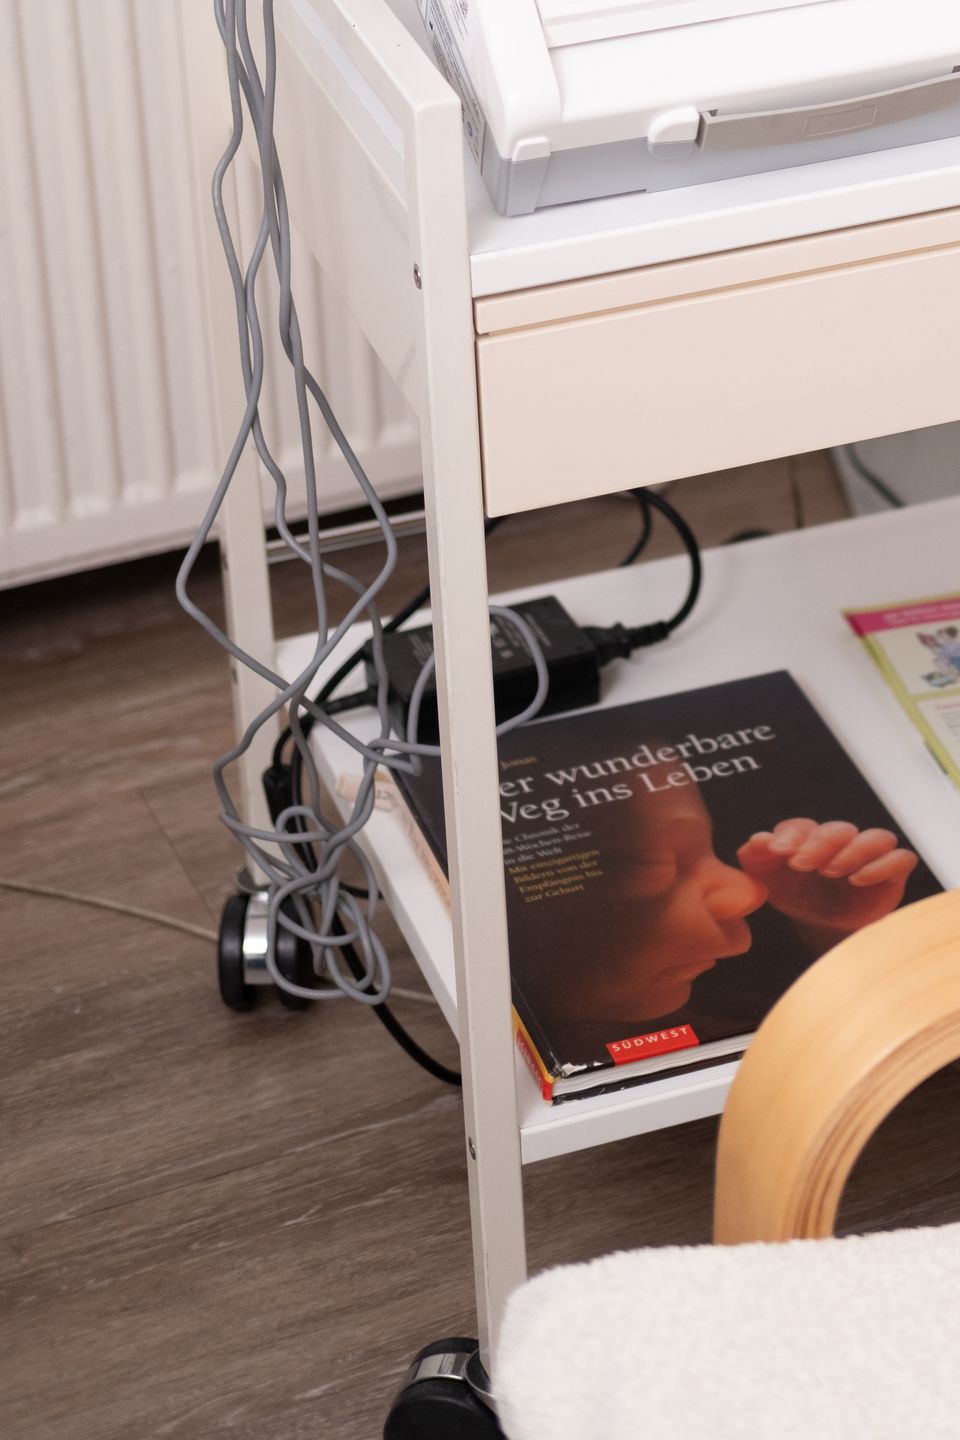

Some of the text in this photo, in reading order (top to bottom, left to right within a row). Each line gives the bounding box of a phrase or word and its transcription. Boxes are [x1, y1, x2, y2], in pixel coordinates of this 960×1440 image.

[500, 724, 776, 798] er wunderbare
[572, 782, 634, 808] ins
[638, 755, 762, 793] Leben
[612, 1027, 689, 1052] SÜDWEST
